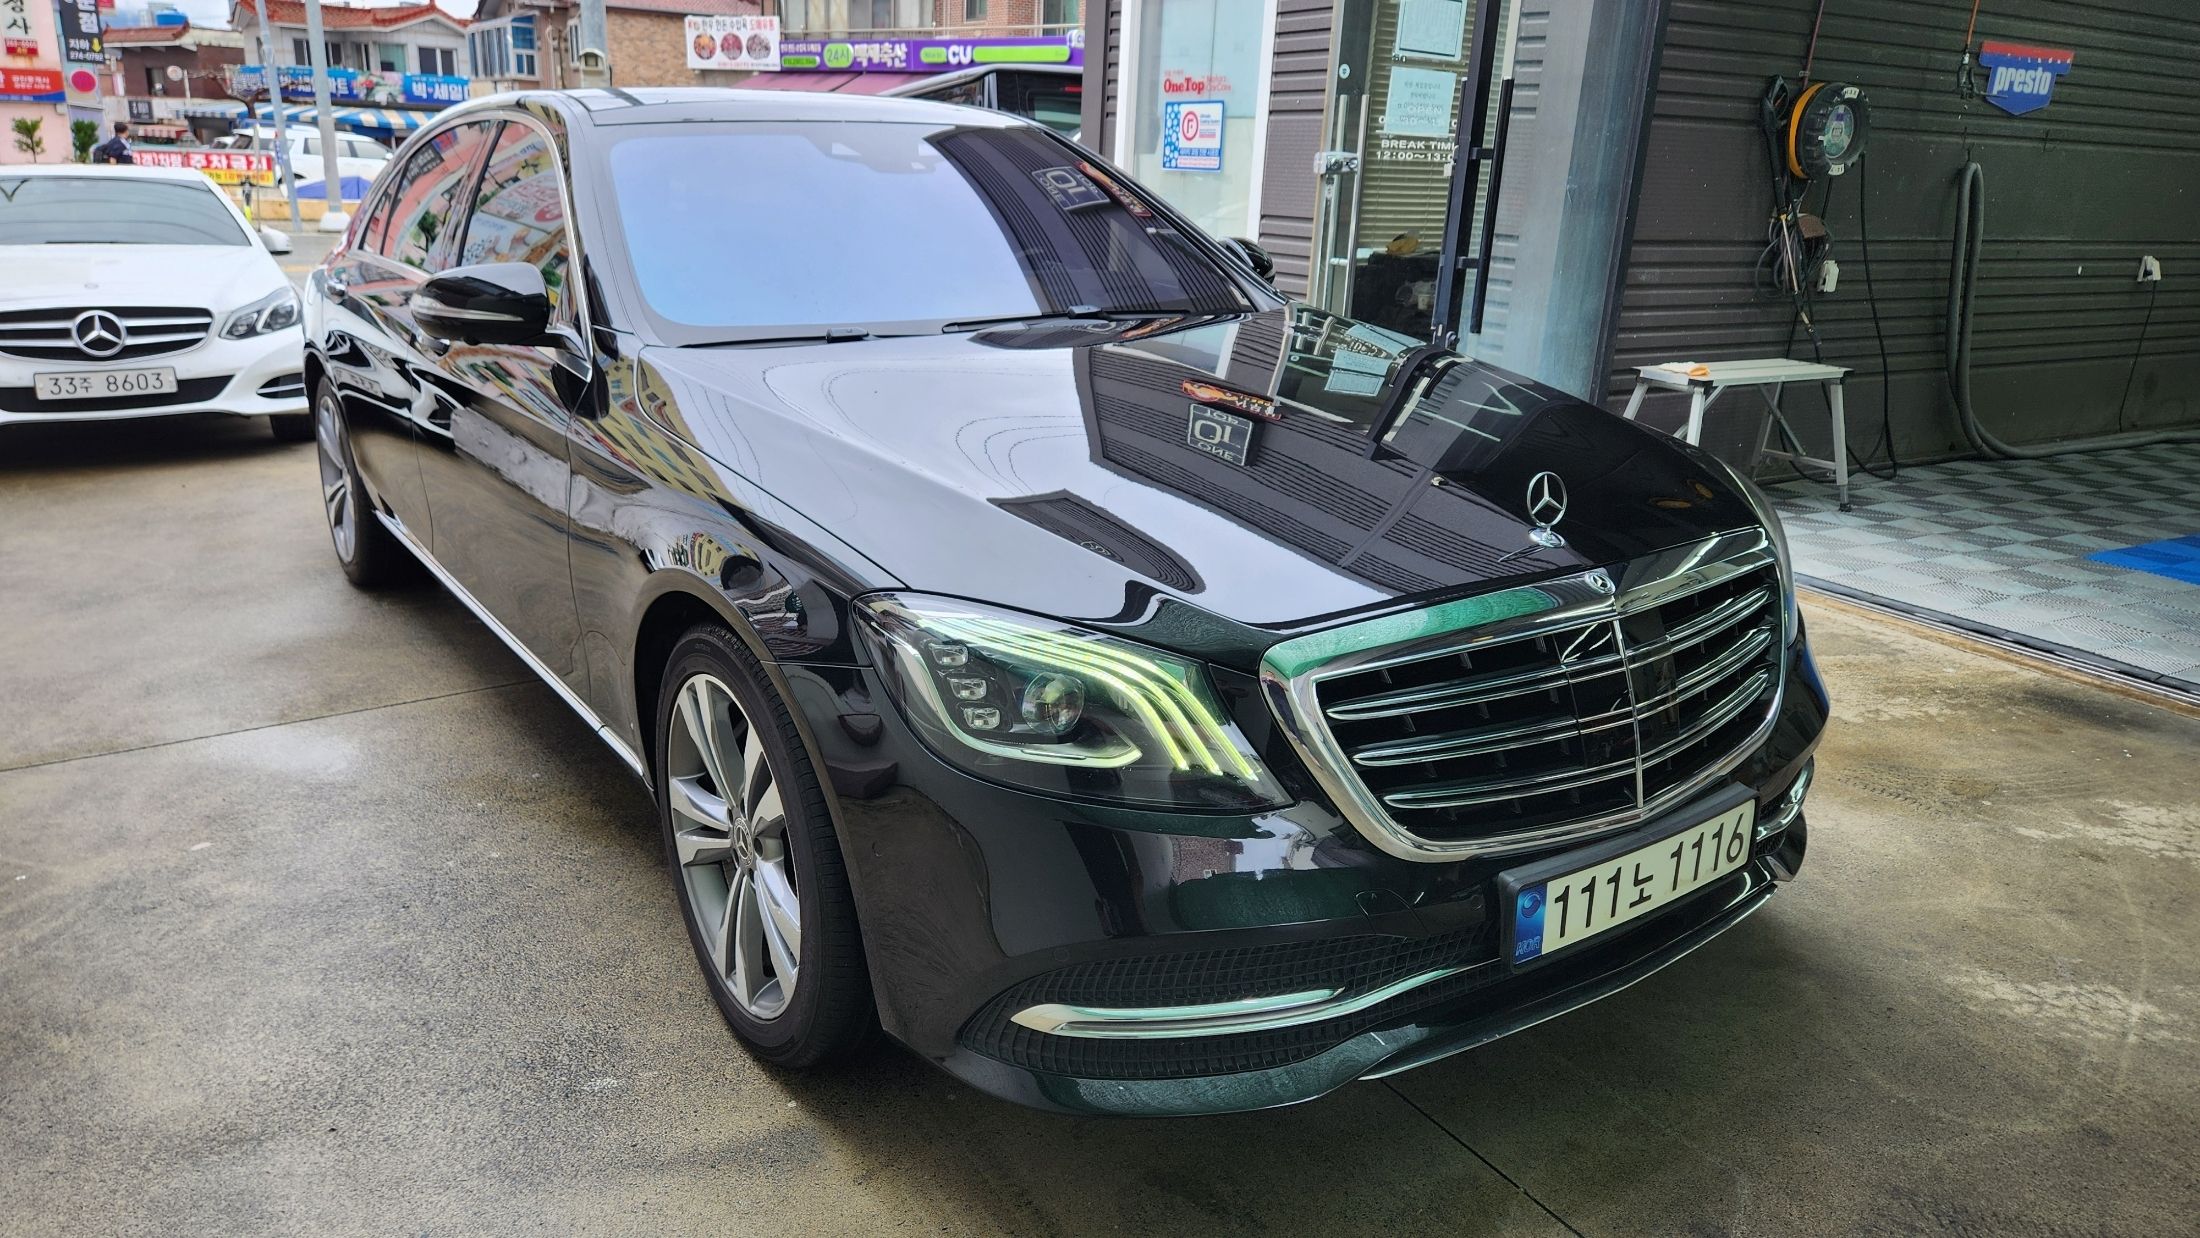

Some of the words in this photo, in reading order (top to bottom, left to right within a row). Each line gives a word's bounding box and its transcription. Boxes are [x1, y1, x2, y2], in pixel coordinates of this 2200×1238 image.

[948, 45, 972, 65] CU
[1164, 77, 1205, 95] OneTop
[1993, 67, 2052, 95] presto
[1381, 139, 1425, 150] BREAK
[49, 377, 93, 396] 33주
[106, 373, 164, 393] 8603
[1554, 862, 1654, 938] 111노
[1670, 813, 1744, 892] 1116
[1515, 935, 1541, 957] KOR
